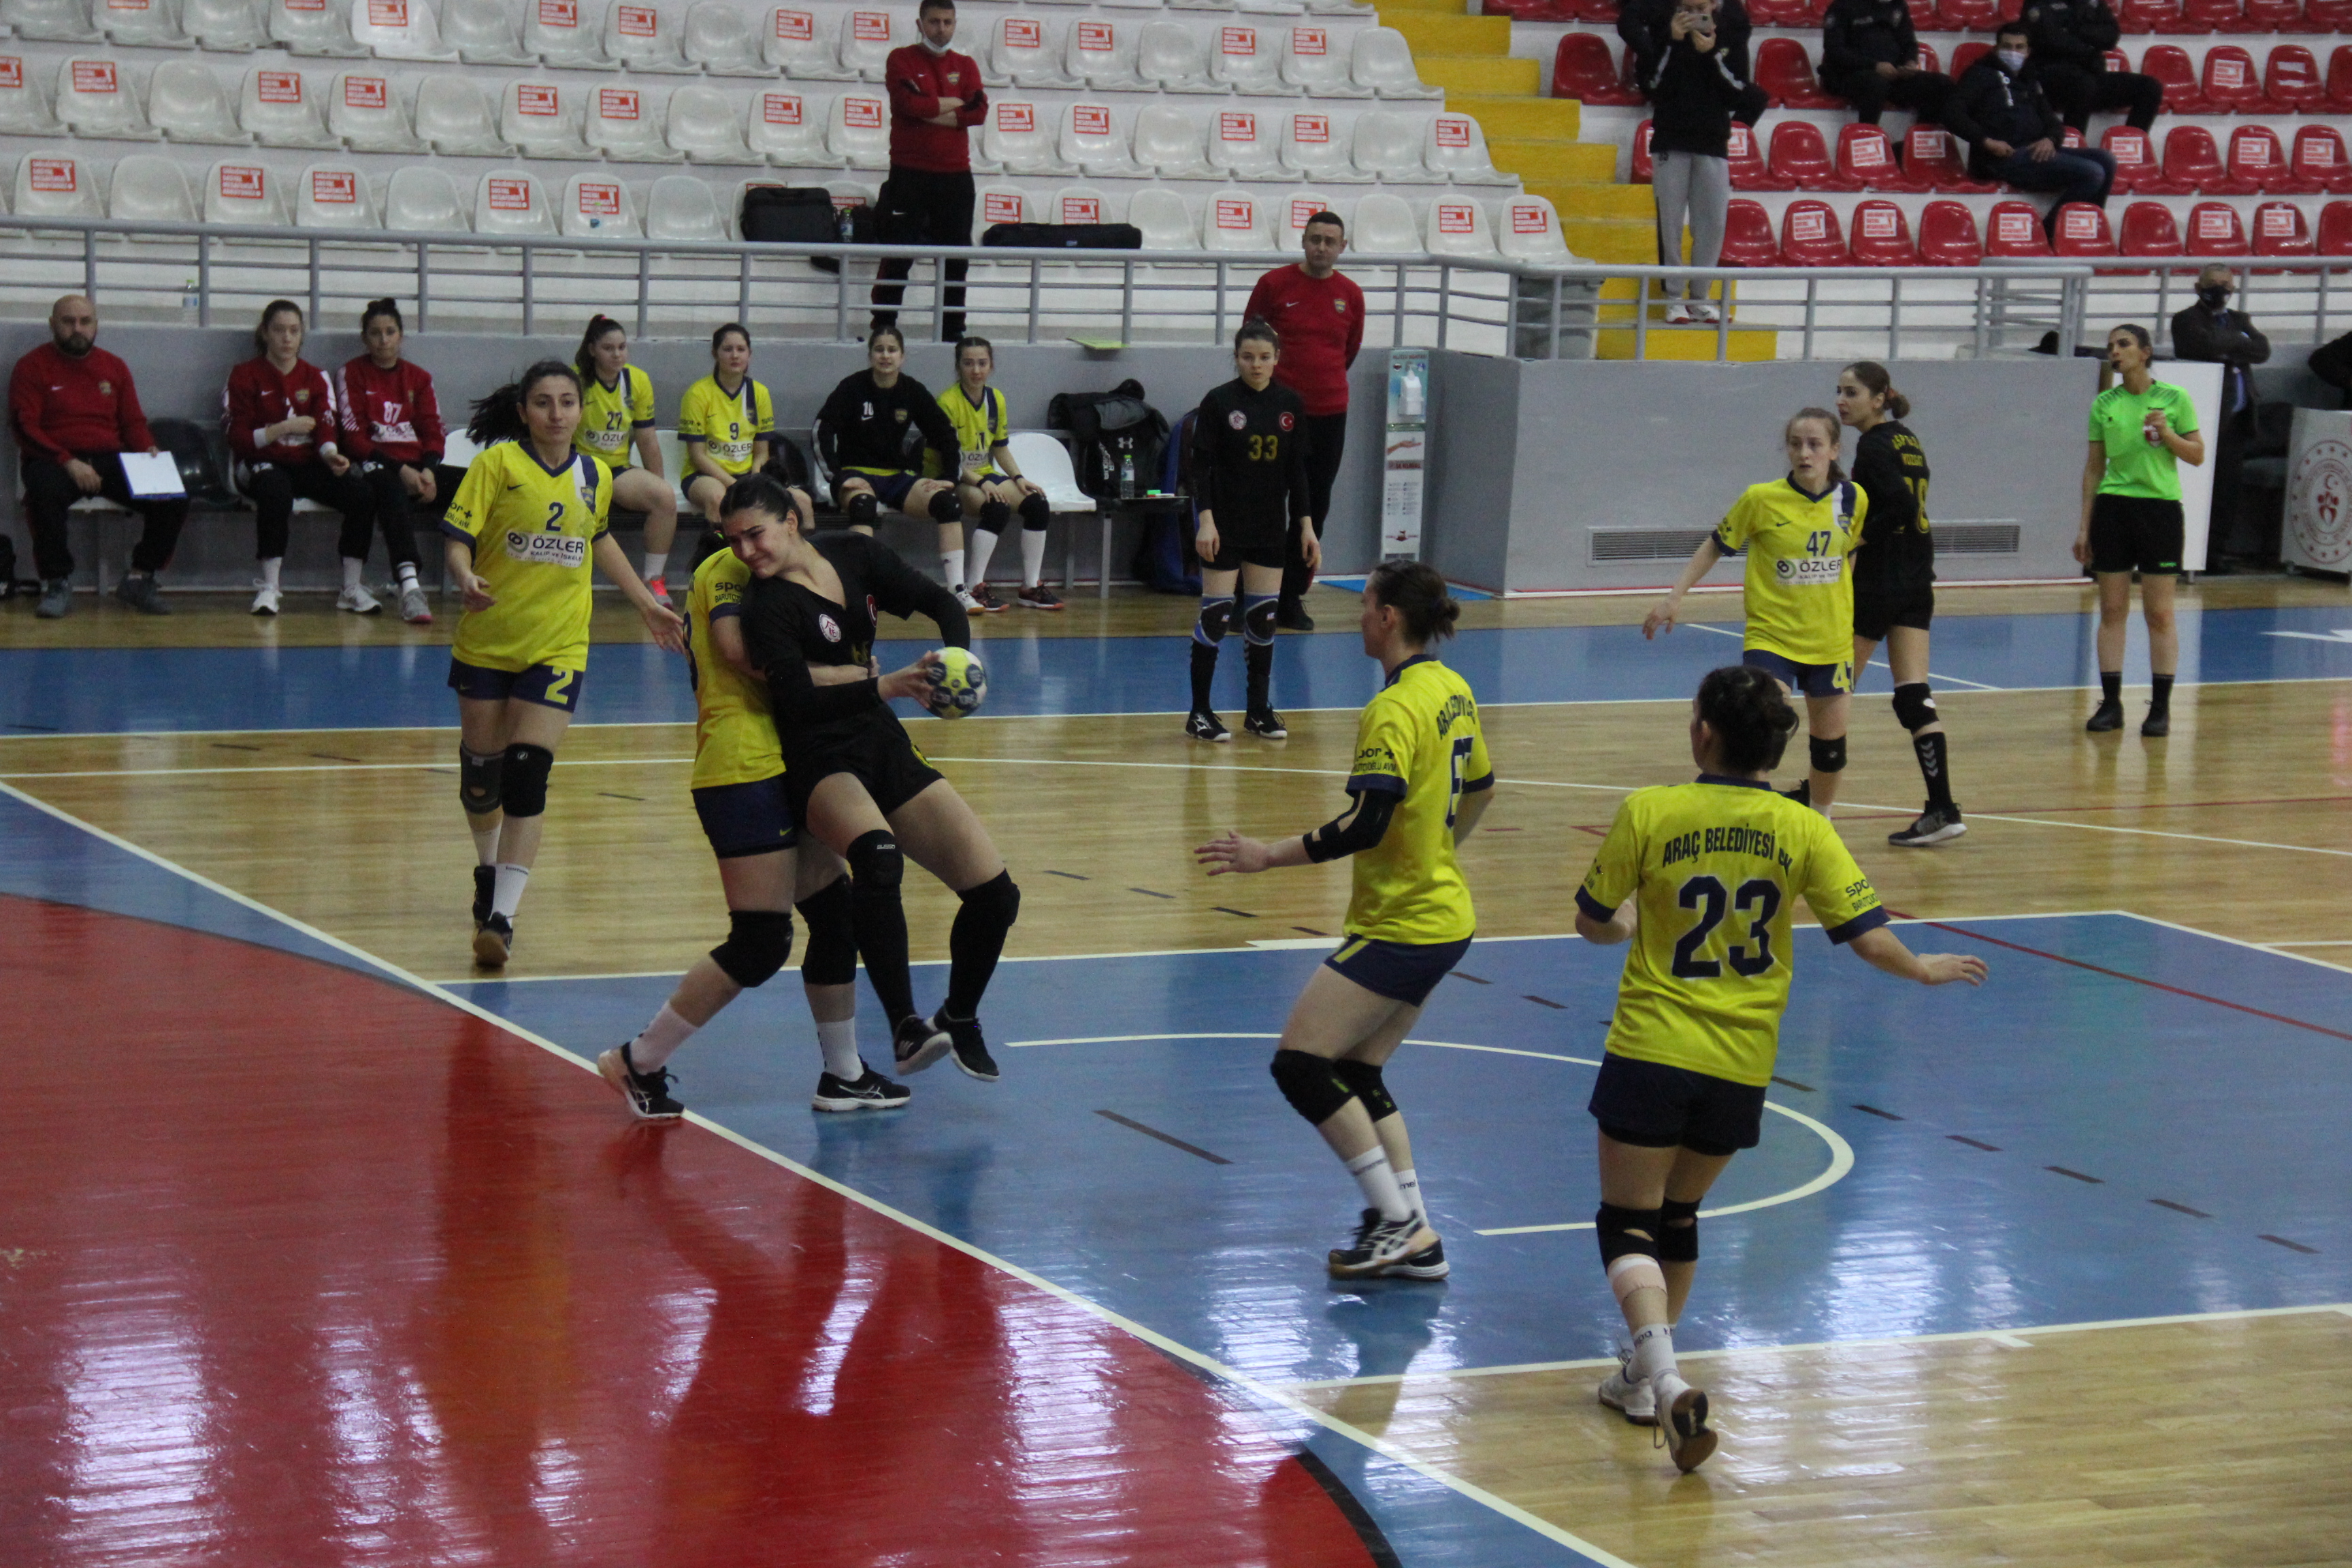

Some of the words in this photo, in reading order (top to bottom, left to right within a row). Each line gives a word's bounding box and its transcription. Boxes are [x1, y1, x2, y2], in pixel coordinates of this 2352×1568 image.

[606, 411, 623, 429] 27
[730, 423, 738, 440] 9
[1249, 435, 1278, 459] 33
[545, 502, 564, 532] 2
[533, 535, 584, 553] ÖZLER
[1806, 530, 1832, 557] 47
[544, 666, 574, 704] 2
[1663, 830, 1701, 868] ARAÇ
[1705, 823, 1776, 860] BELEDİYESİ
[1671, 875, 1781, 978] 23
